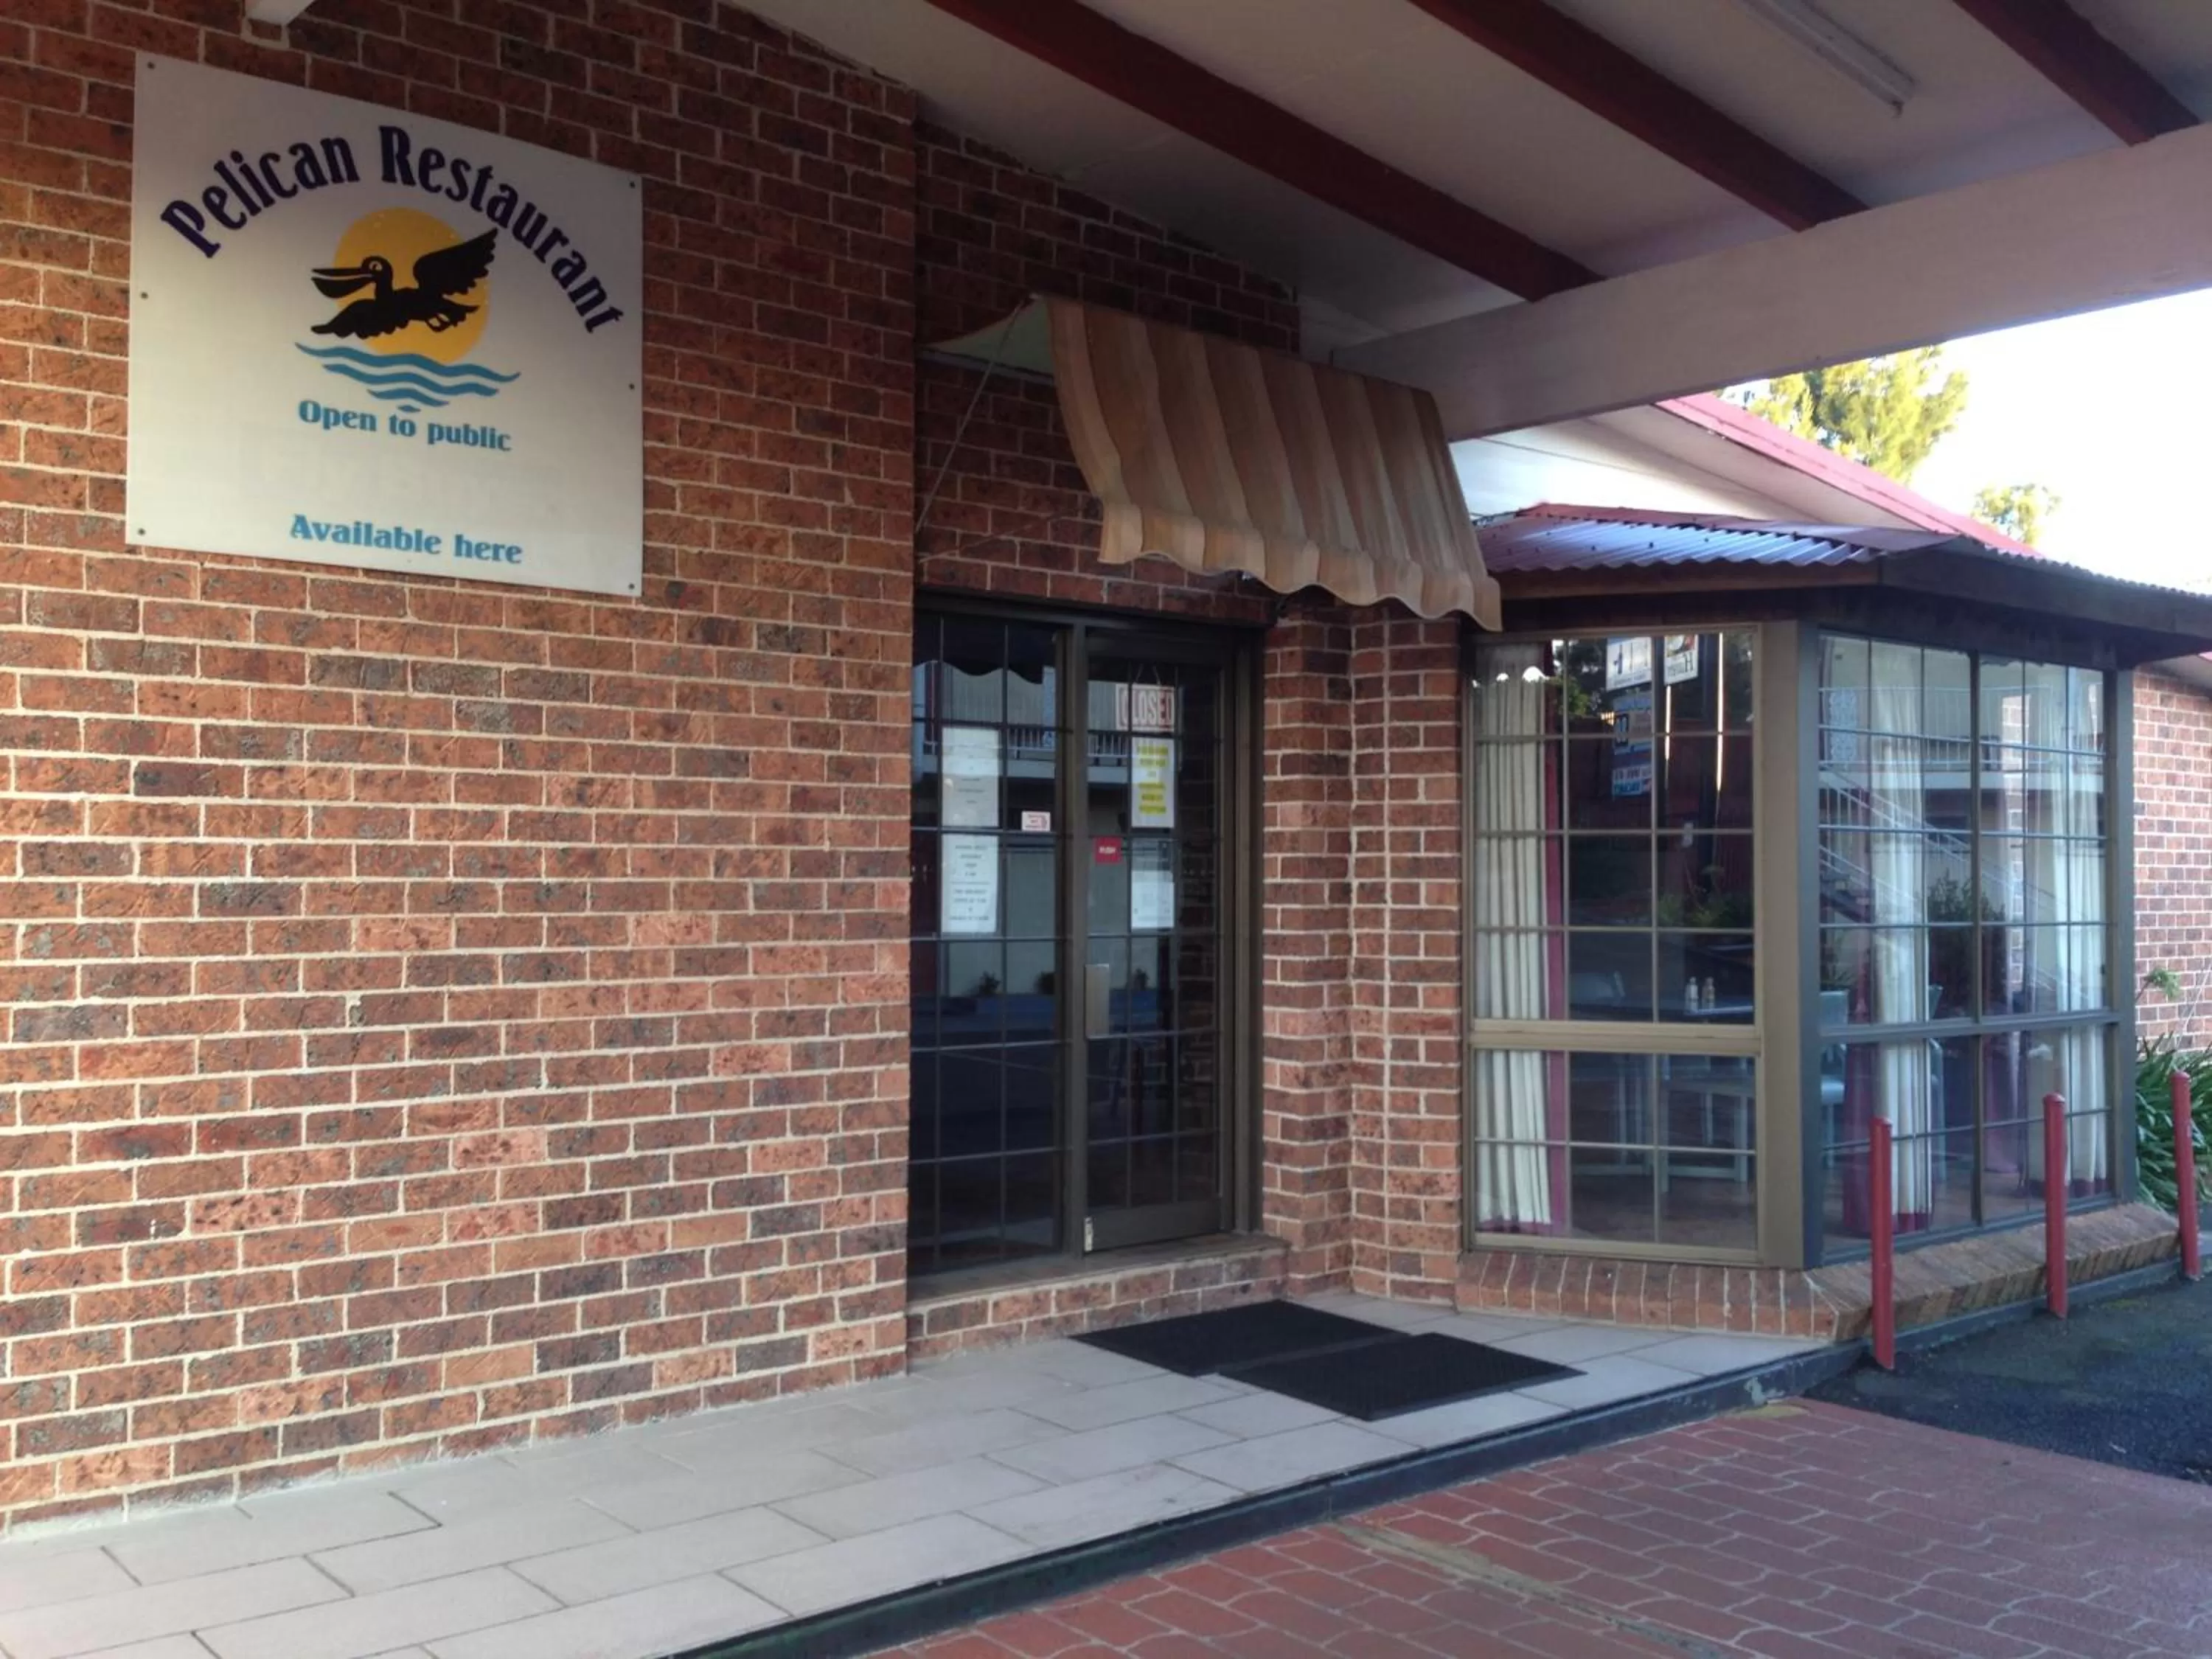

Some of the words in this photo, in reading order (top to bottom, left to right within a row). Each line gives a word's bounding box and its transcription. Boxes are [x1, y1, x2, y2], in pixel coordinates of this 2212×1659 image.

[160, 136, 360, 259] Pelican
[378, 125, 625, 335] Restaurant
[298, 400, 377, 433] Open
[388, 414, 417, 438] to
[428, 423, 511, 453] public
[291, 515, 442, 554] Available
[453, 533, 523, 565] here
[1120, 689, 1174, 726] CLOSED
